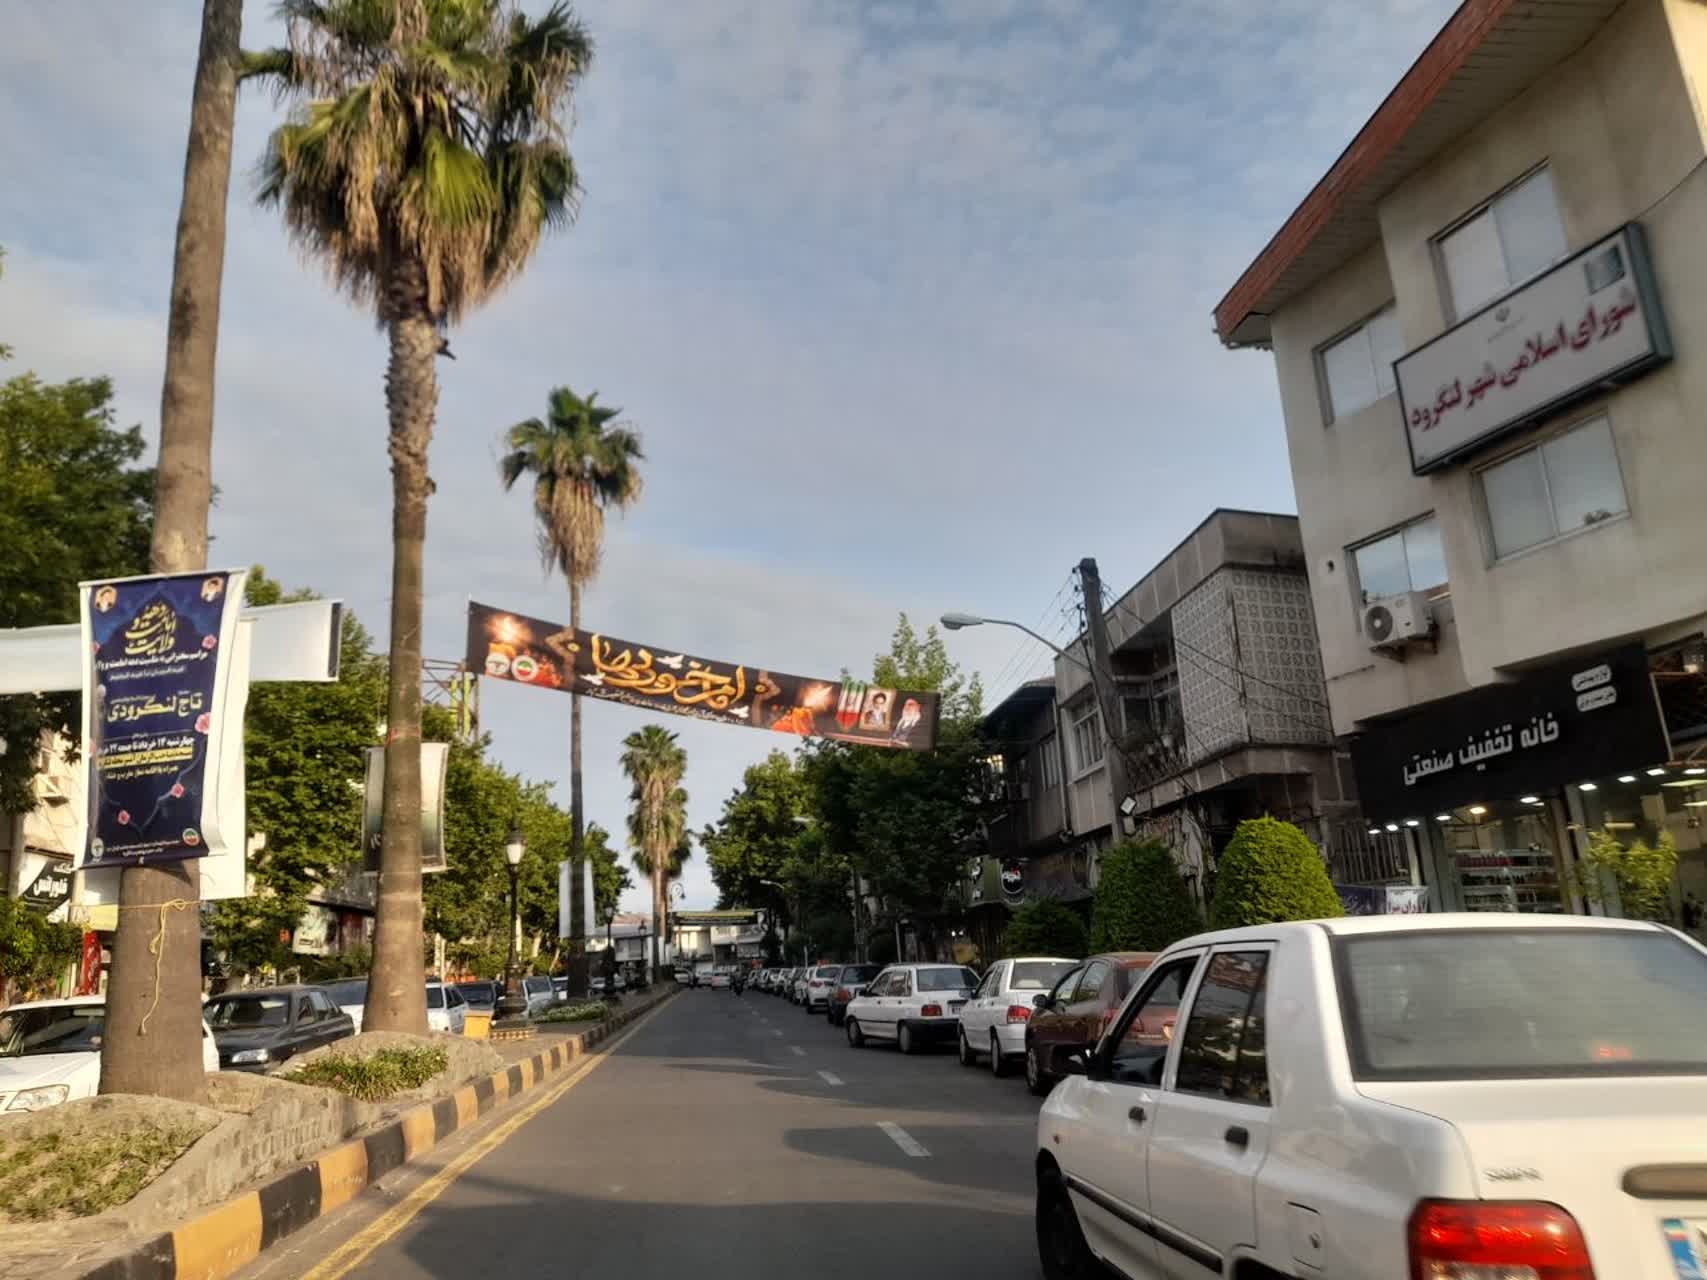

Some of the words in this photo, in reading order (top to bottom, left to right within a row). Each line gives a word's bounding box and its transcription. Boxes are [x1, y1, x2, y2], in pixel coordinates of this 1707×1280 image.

[1570, 288, 1636, 350] شورای
[1501, 320, 1568, 388] اسلامی
[1411, 378, 1462, 431] لنگرود
[1466, 360, 1497, 409] شهر
[125, 631, 176, 657] ولایت
[178, 692, 203, 718] تاج
[1458, 723, 1514, 771] تخفیف
[1520, 711, 1560, 750] خانه
[1403, 750, 1455, 786] صنعتی
